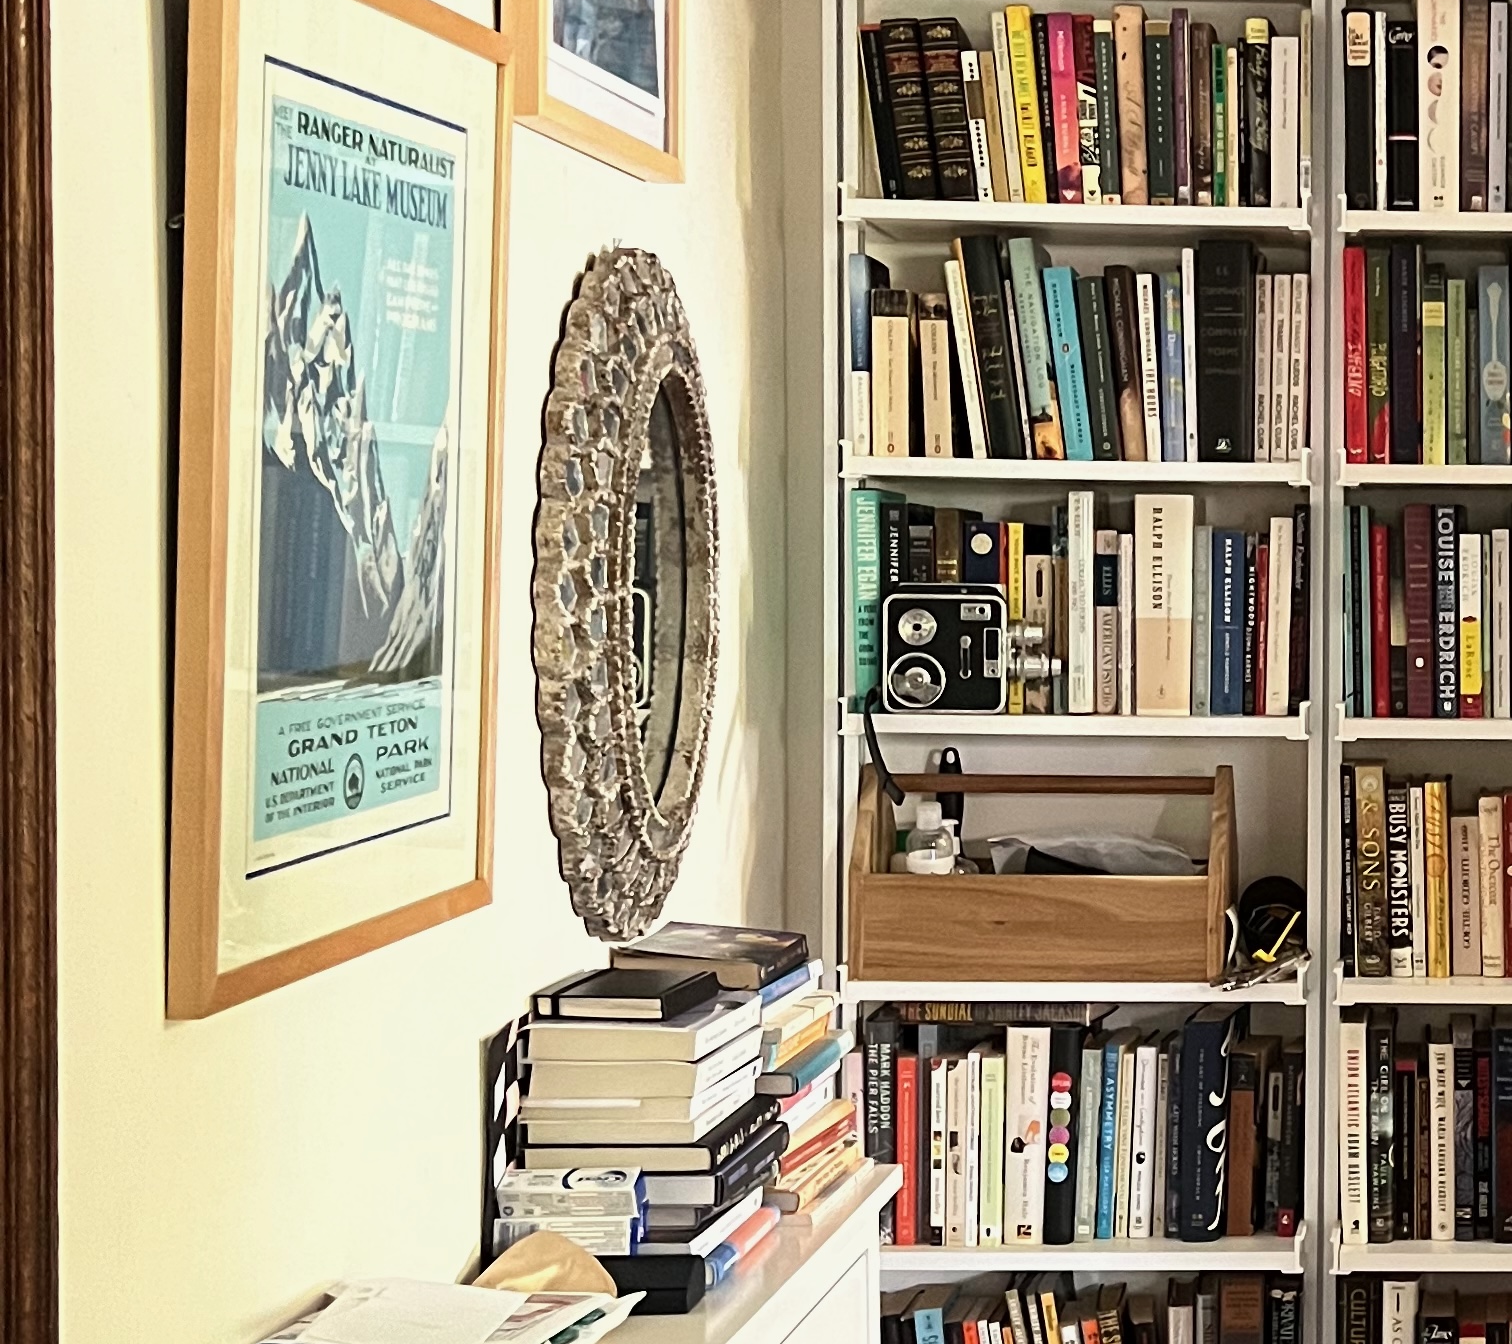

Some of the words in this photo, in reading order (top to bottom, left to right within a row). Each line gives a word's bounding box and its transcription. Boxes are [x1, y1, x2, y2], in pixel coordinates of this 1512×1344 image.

[298, 111, 363, 151] RANGER
[368, 133, 455, 180] NATURALIST
[285, 144, 341, 197] JENNY
[342, 162, 382, 209] LAKE
[386, 174, 448, 229] MUSEUM
[856, 496, 872, 550] JENNIFER
[1152, 506, 1163, 549] RALPH
[1438, 508, 1454, 581] LOUISE
[858, 552, 877, 601] EGAN
[890, 524, 900, 582] JENNIFER
[1224, 538, 1233, 572] RALPH
[1151, 552, 1164, 611] ELLISON
[1223, 575, 1233, 623] ELLISON
[1438, 603, 1455, 700] ERDRICH
[289, 720, 311, 734] FREE
[317, 707, 383, 729] GOVERNMENT
[387, 698, 425, 716] SERVICE
[289, 729, 358, 757] GRAND
[367, 716, 418, 738] TETON
[271, 758, 334, 787] NATIONAL
[376, 736, 429, 761] PARK
[376, 763, 411, 779] NATIONAL
[381, 772, 425, 793] SERVICE
[1362, 801, 1378, 816] &
[1390, 801, 1405, 851] BUSY
[1362, 828, 1381, 891] SONS
[1389, 853, 1409, 938] MONSTERS
[924, 1004, 973, 1019] SUNDIAL
[869, 1043, 878, 1062] THE
[880, 1043, 891, 1072] MARK
[1380, 1060, 1389, 1090] GIRL
[869, 1065, 878, 1092] PIER
[880, 1075, 891, 1130] HADDON
[868, 1095, 878, 1135] FALLS
[1104, 1068, 1116, 1153] ASYMMETRY
[1348, 1082, 1359, 1133] ATLANTIC
[1392, 1317, 1402, 1330] AS
